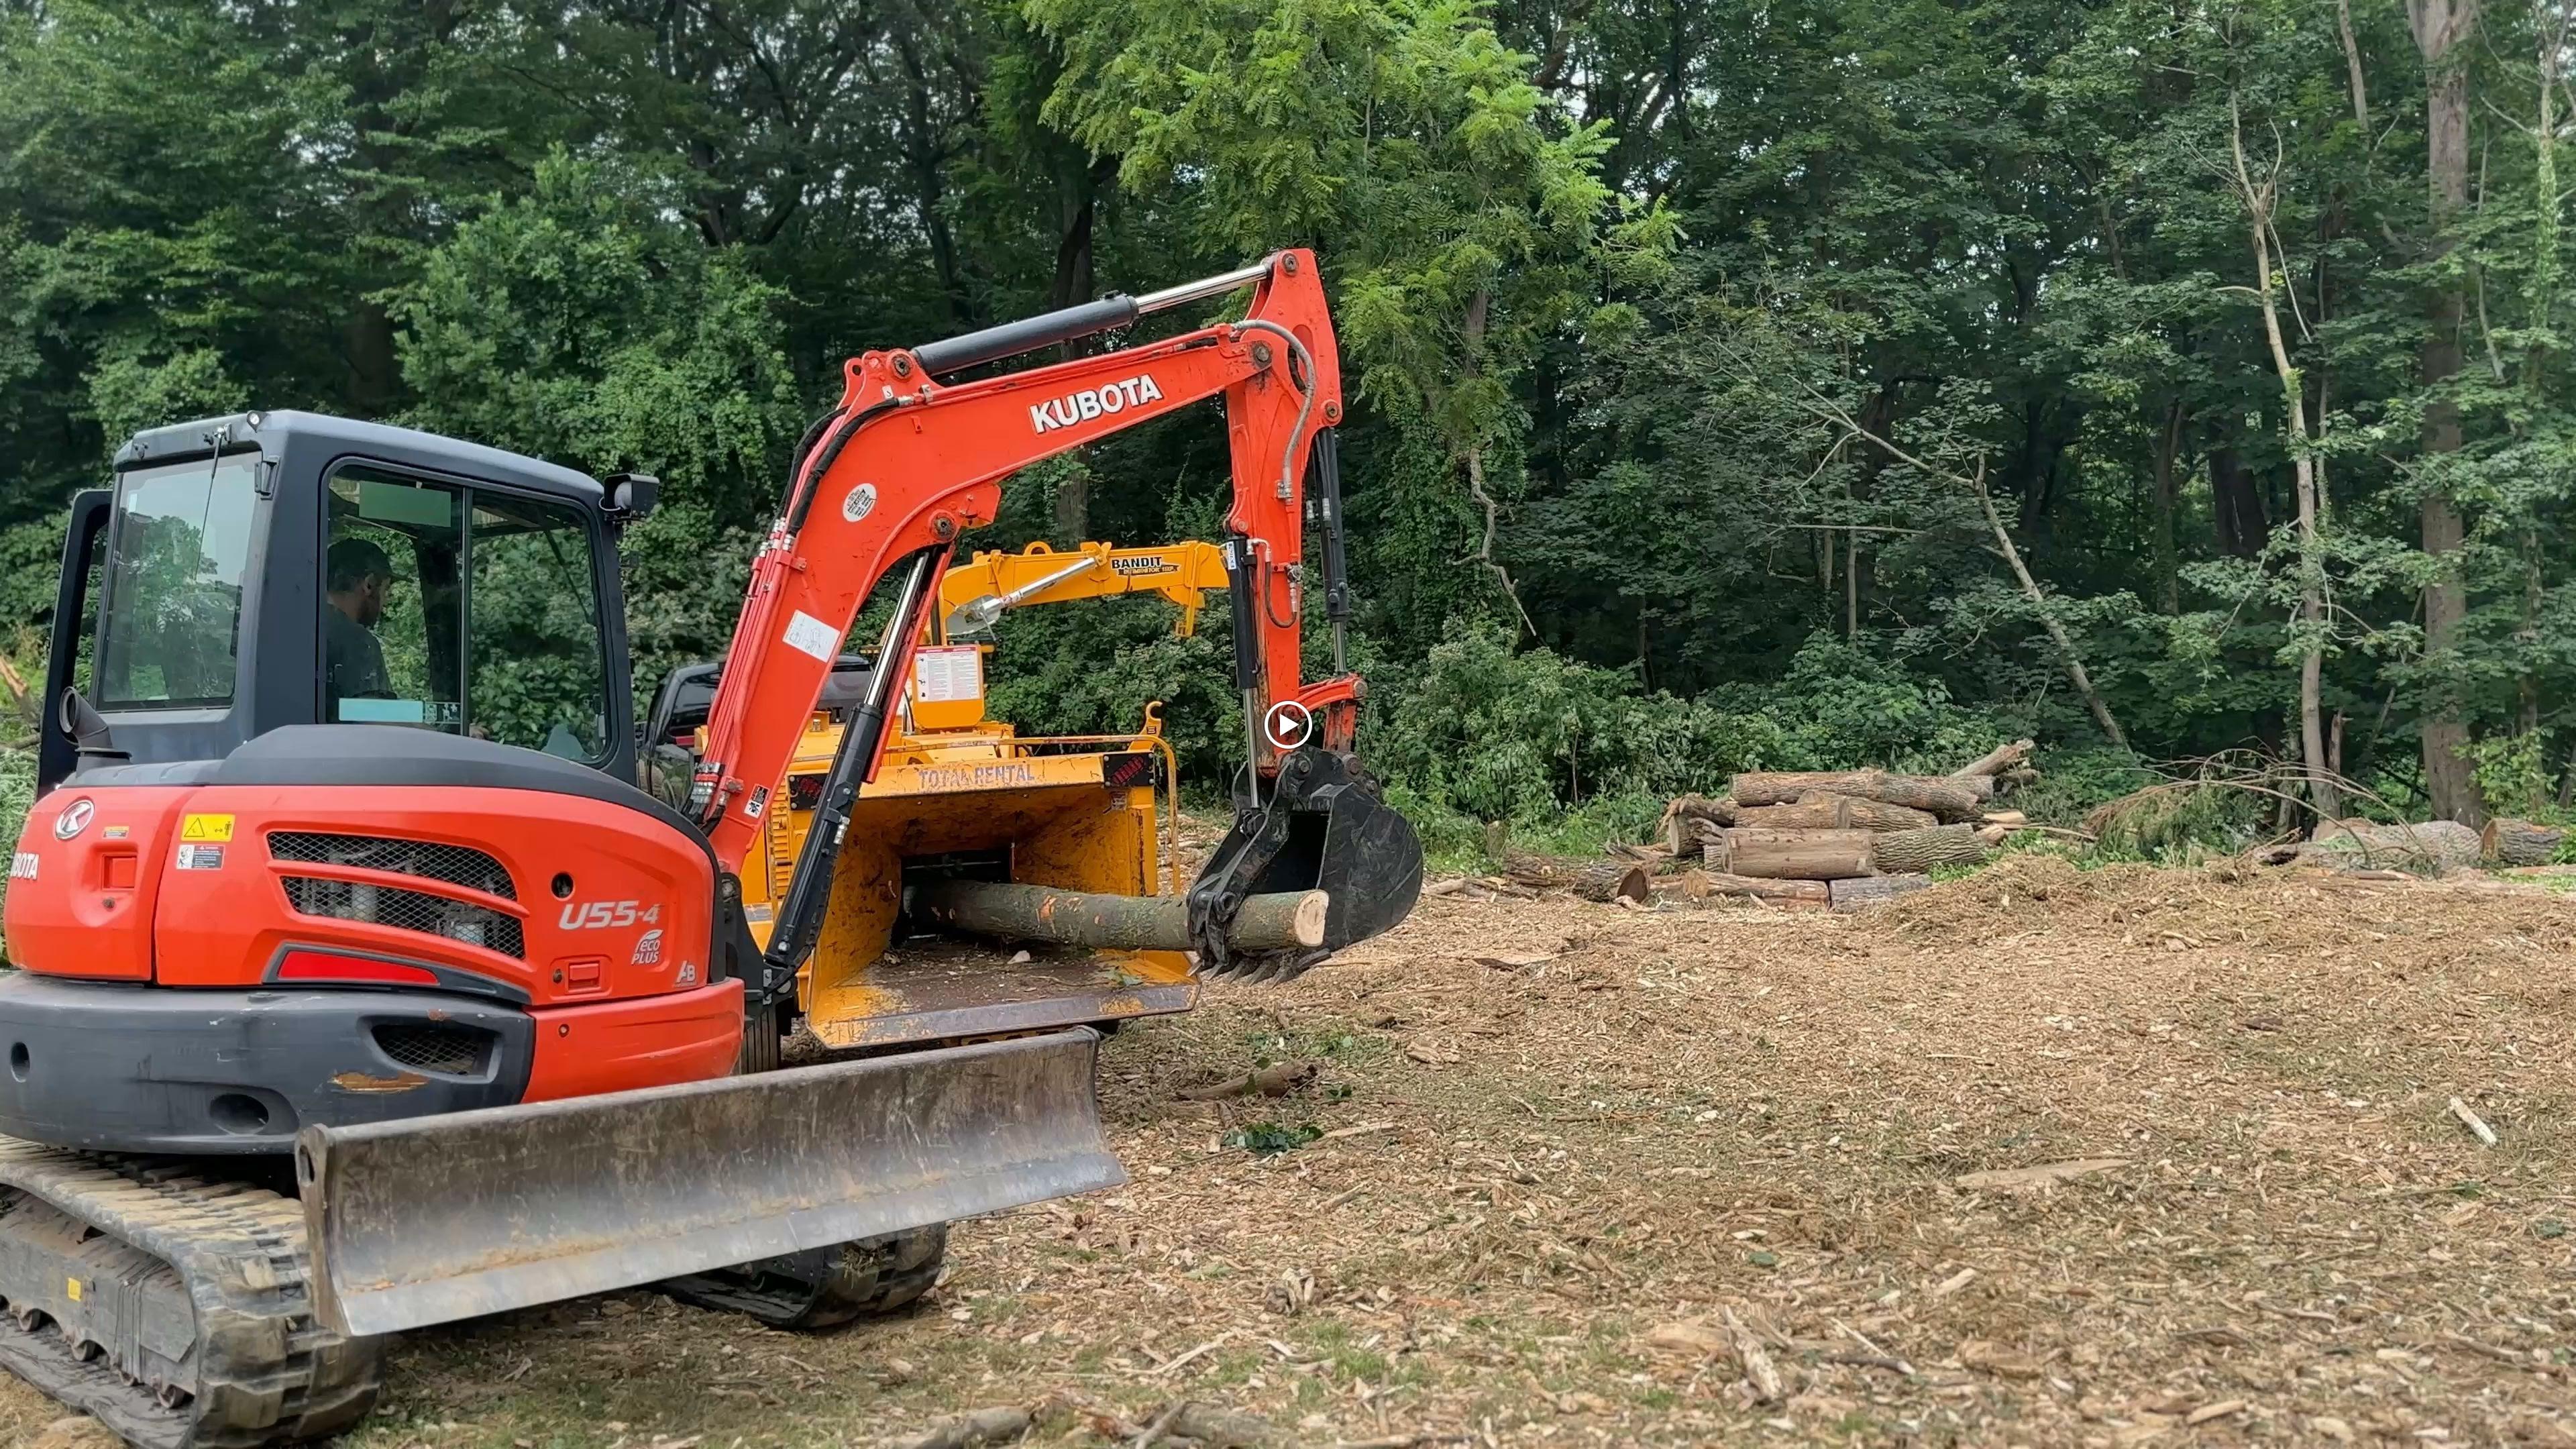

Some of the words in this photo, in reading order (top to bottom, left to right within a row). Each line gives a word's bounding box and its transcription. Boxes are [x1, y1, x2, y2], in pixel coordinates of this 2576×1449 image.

[1029, 374, 1163, 433] KUBOTA
[1112, 557, 1162, 569] BANDIT
[918, 767, 970, 788] TOTAL
[974, 764, 1035, 785] RENTAL
[559, 900, 660, 930] U55-4
[639, 939, 661, 952] eco
[631, 951, 659, 965] PLUS
